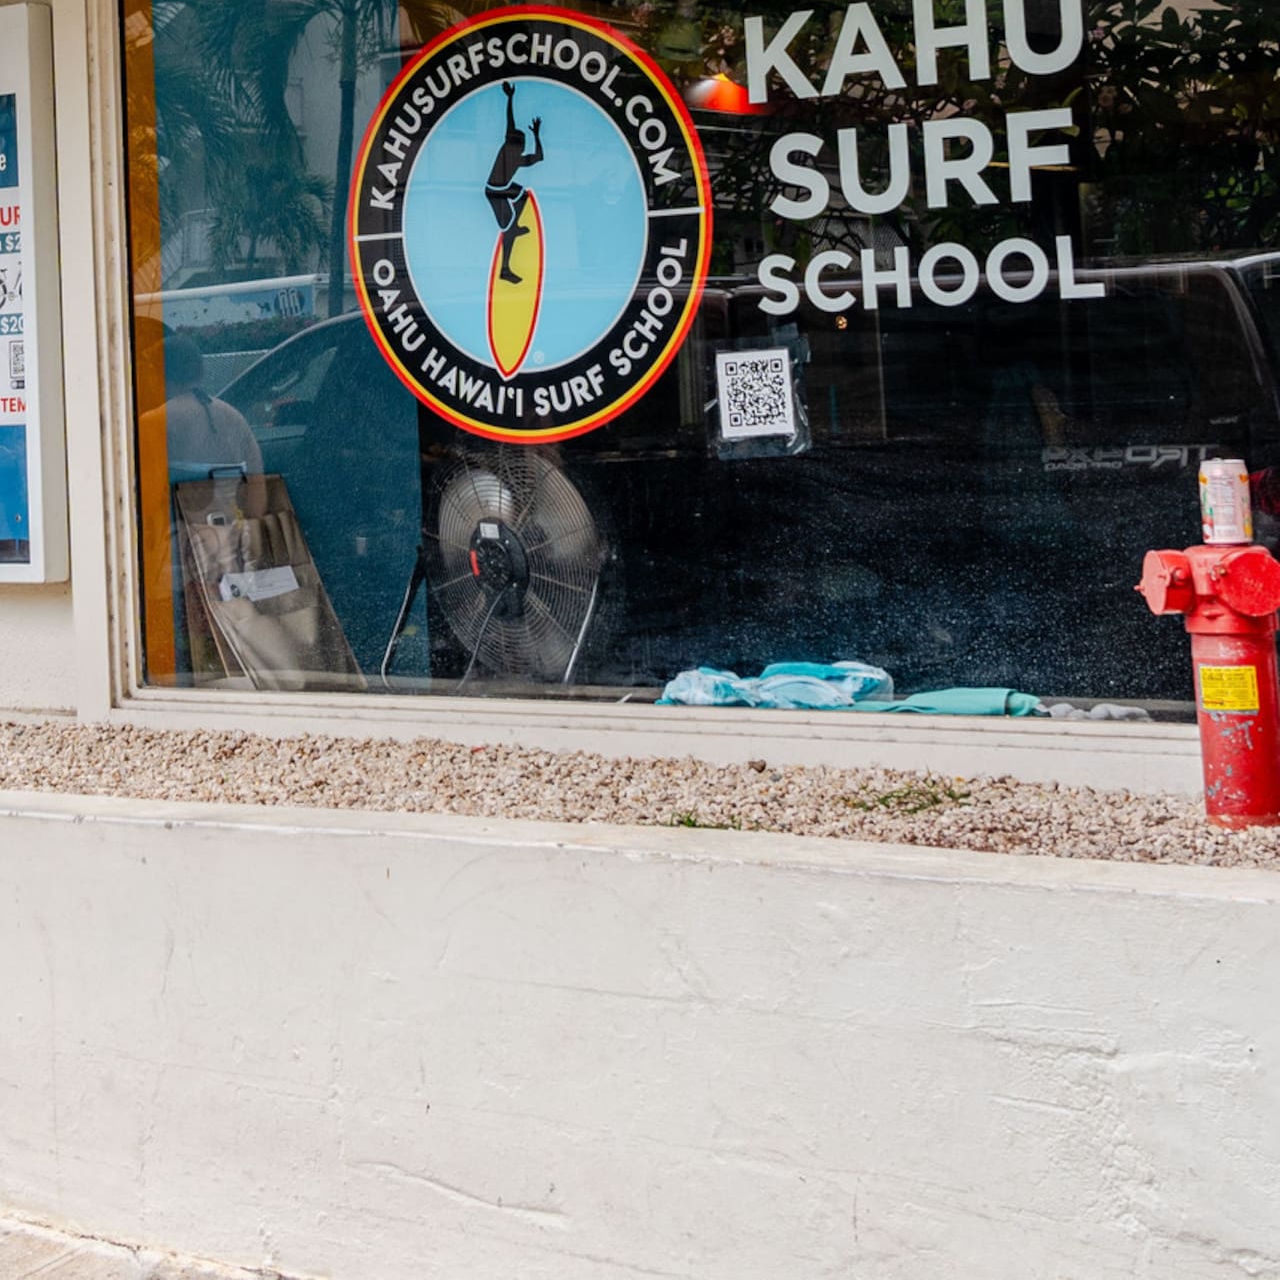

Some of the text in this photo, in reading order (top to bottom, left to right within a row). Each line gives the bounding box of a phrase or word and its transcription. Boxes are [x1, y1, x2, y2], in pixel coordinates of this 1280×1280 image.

[370, 32, 682, 211] KAHUSURFSCHOOL.COM
[769, 107, 1073, 220] SURF
[373, 259, 425, 352] OAHU
[534, 363, 606, 417] SURF
[608, 239, 687, 376] SCHOOL
[758, 235, 1106, 315] SCHOOL
